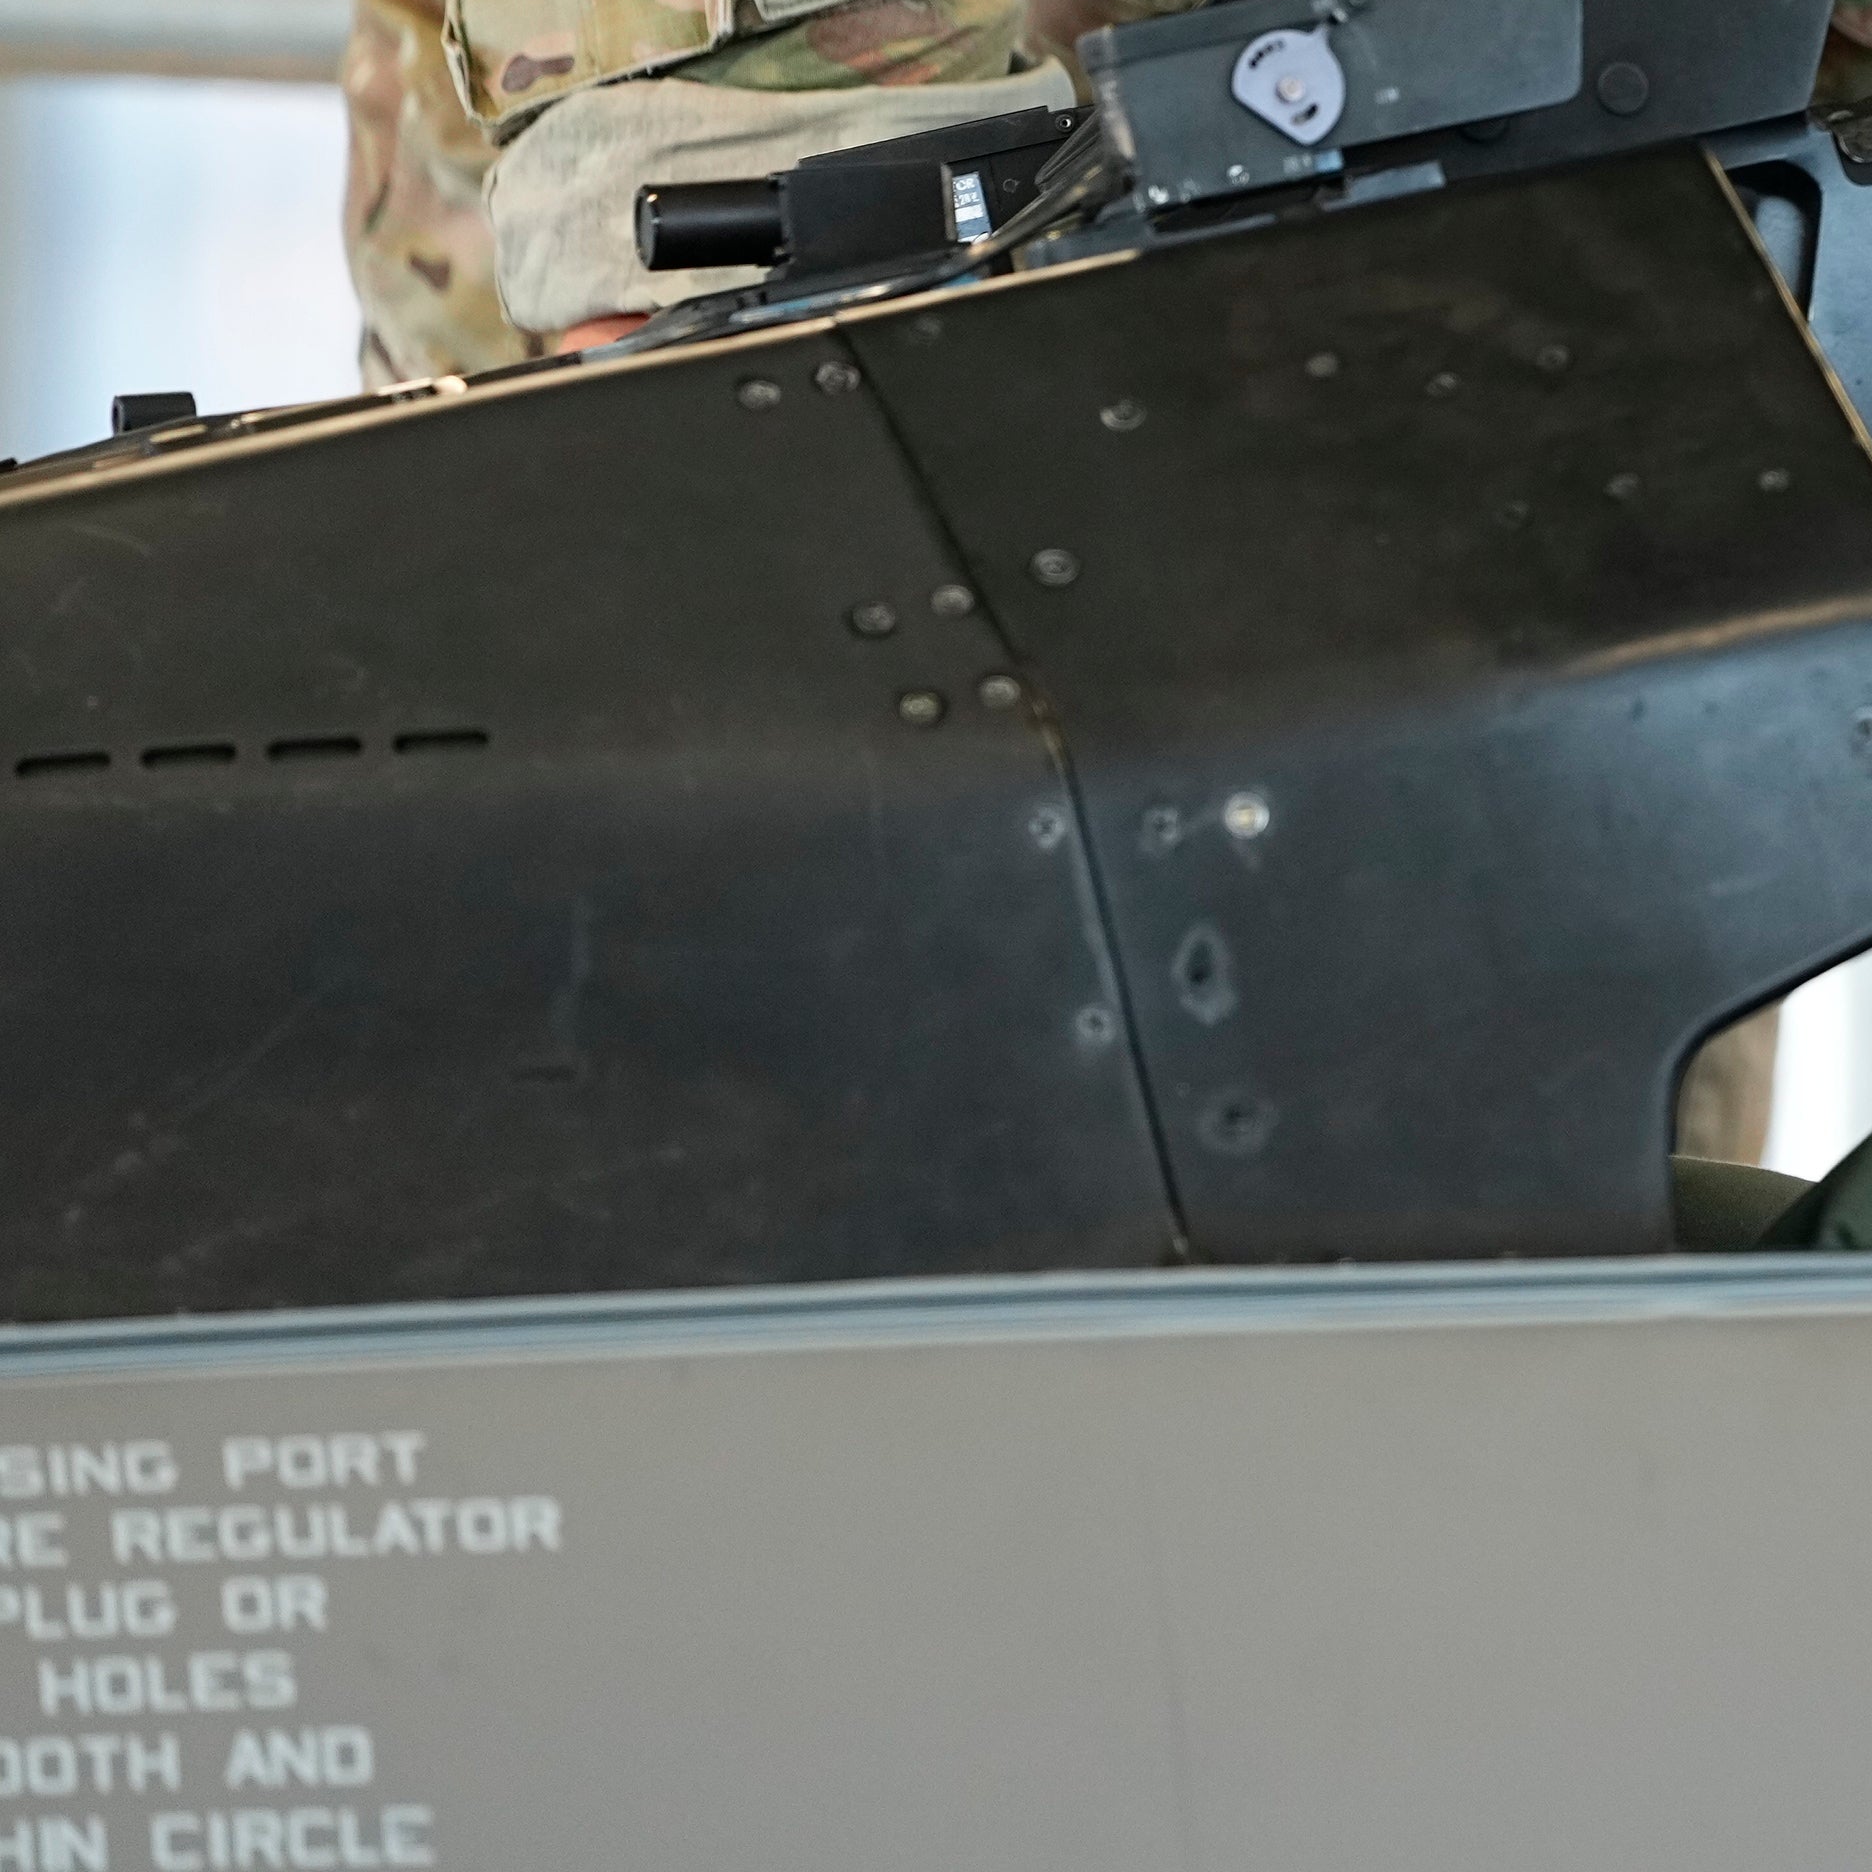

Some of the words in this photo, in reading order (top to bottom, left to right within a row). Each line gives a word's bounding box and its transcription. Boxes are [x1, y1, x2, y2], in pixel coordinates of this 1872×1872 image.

[223, 1430, 427, 1490] PORT
[0, 1510, 68, 1568] E
[112, 1496, 563, 1565] REGULATOR
[221, 1574, 330, 1635] OR
[38, 1650, 297, 1717] HOLES
[225, 1725, 374, 1790] AND
[151, 1803, 435, 1871] CIRCLE
